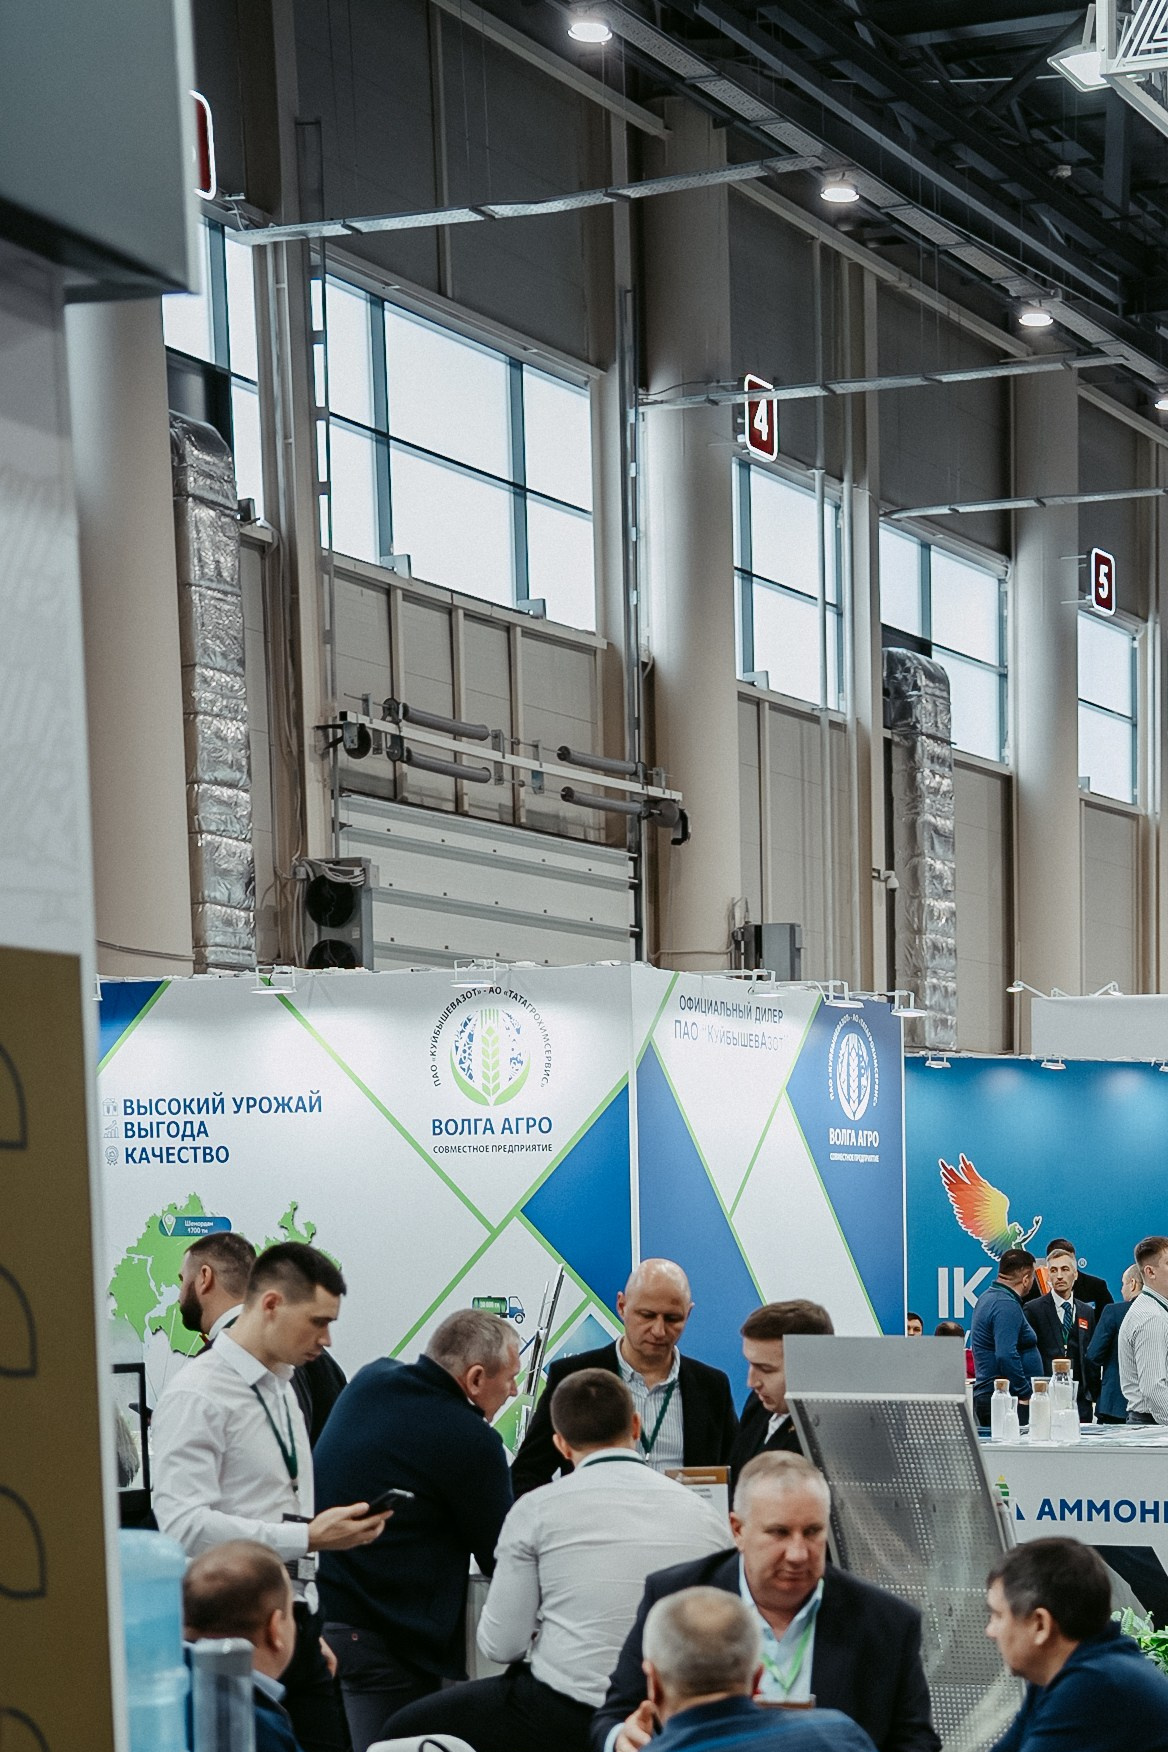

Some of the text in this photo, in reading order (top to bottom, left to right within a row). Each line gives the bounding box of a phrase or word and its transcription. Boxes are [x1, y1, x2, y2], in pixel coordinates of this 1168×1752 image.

[754, 398, 769, 441] 4
[1098, 564, 1109, 599] 5
[679, 995, 784, 1024] ОФИЦИАЛЬНЫЙ ДИЛЕР
[430, 1062, 442, 1088] ПАО
[488, 986, 502, 995] АО
[674, 1019, 699, 1041] ПАО
[122, 1089, 323, 1116] ВЫСОКИЙ УРОЖАЙ
[123, 1120, 210, 1141] ВЫГОДА
[431, 1116, 553, 1136] ВОЛГА АГРО
[829, 1127, 880, 1148] ВОЛГА АГРО
[124, 1145, 230, 1164] КАЧЕСТВО
[433, 1144, 553, 1154] СОВМЕСТНОЕ ПРЕДПРИЯТИЕ
[937, 1266, 993, 1319] IK
